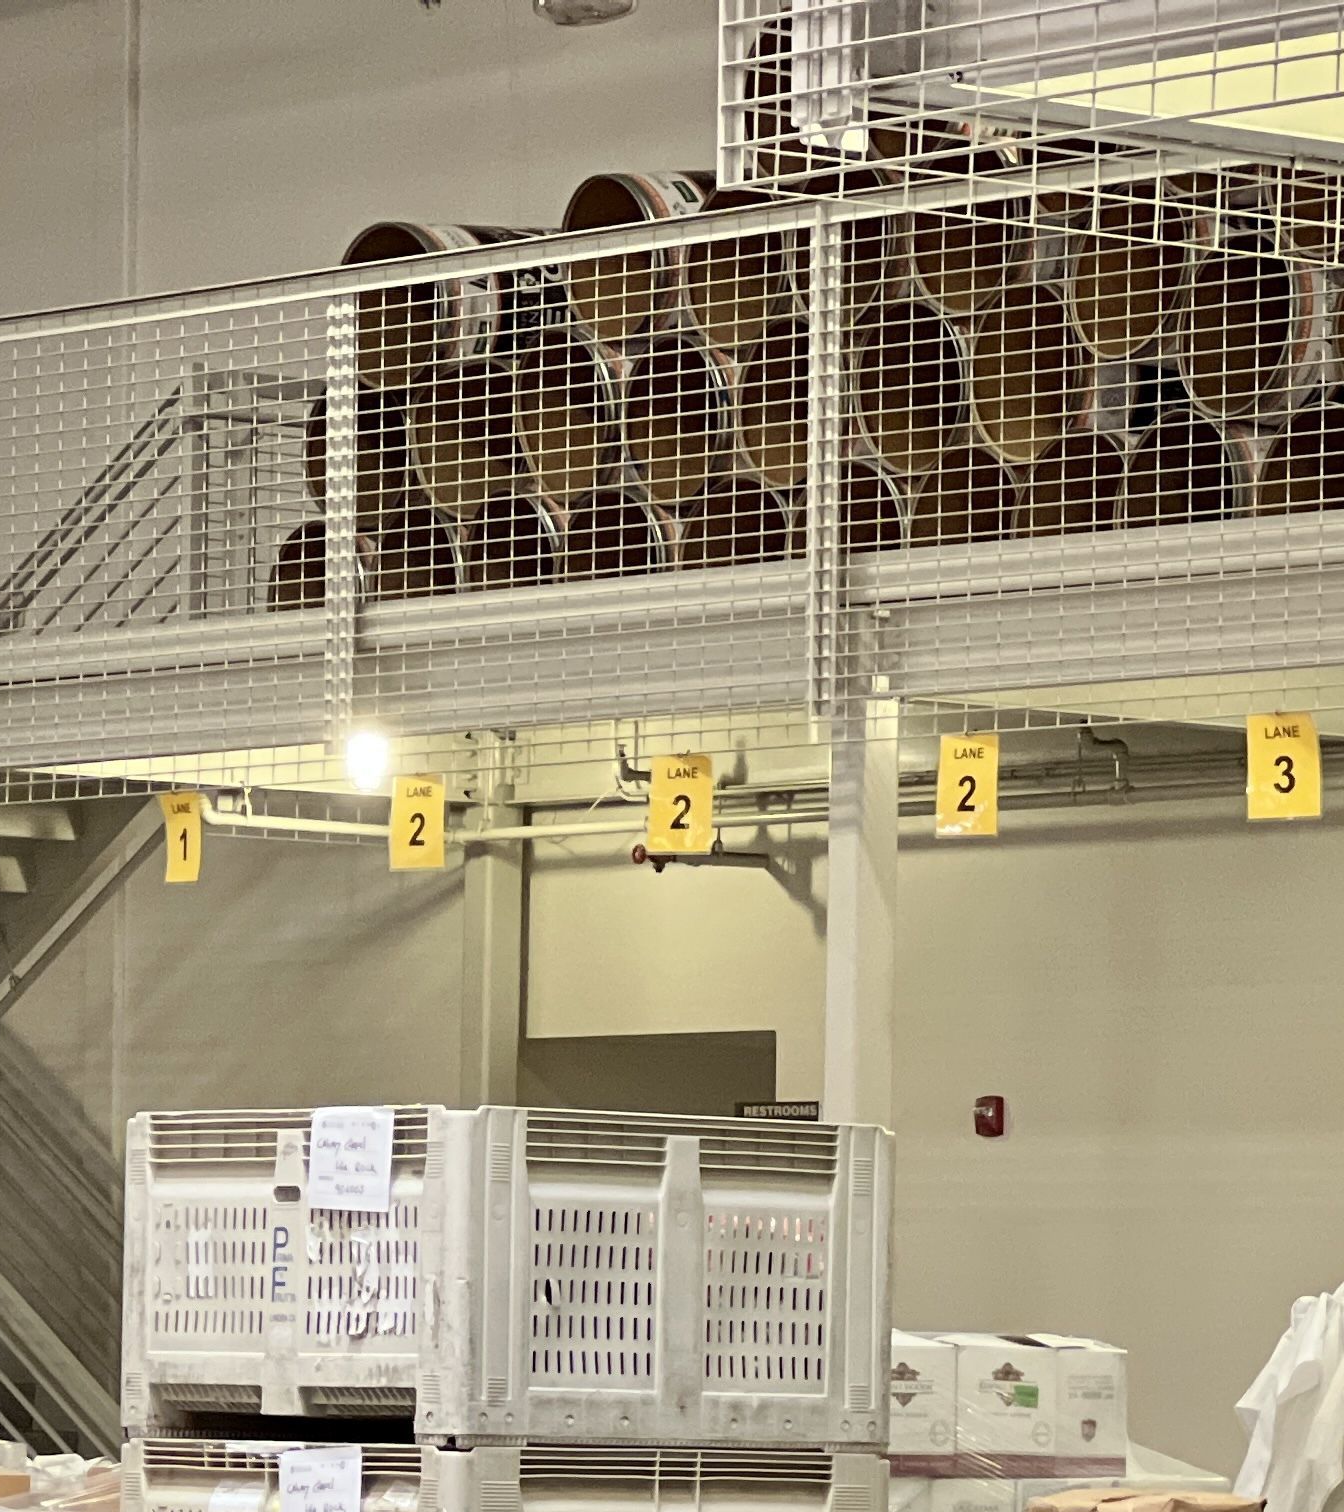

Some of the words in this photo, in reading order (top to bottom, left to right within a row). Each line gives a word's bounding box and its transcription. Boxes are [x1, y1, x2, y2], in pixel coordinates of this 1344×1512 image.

[1264, 725, 1300, 739] LANE
[953, 747, 985, 760] LANE
[667, 766, 699, 779] LANE
[1273, 756, 1296, 794] 3
[406, 785, 433, 797] LANE
[957, 775, 977, 812] 2
[171, 802, 192, 814] LANE
[670, 794, 692, 830] 2
[409, 812, 426, 846] 2
[179, 828, 187, 861] 1
[743, 1105, 817, 1117] RESTROOMS
